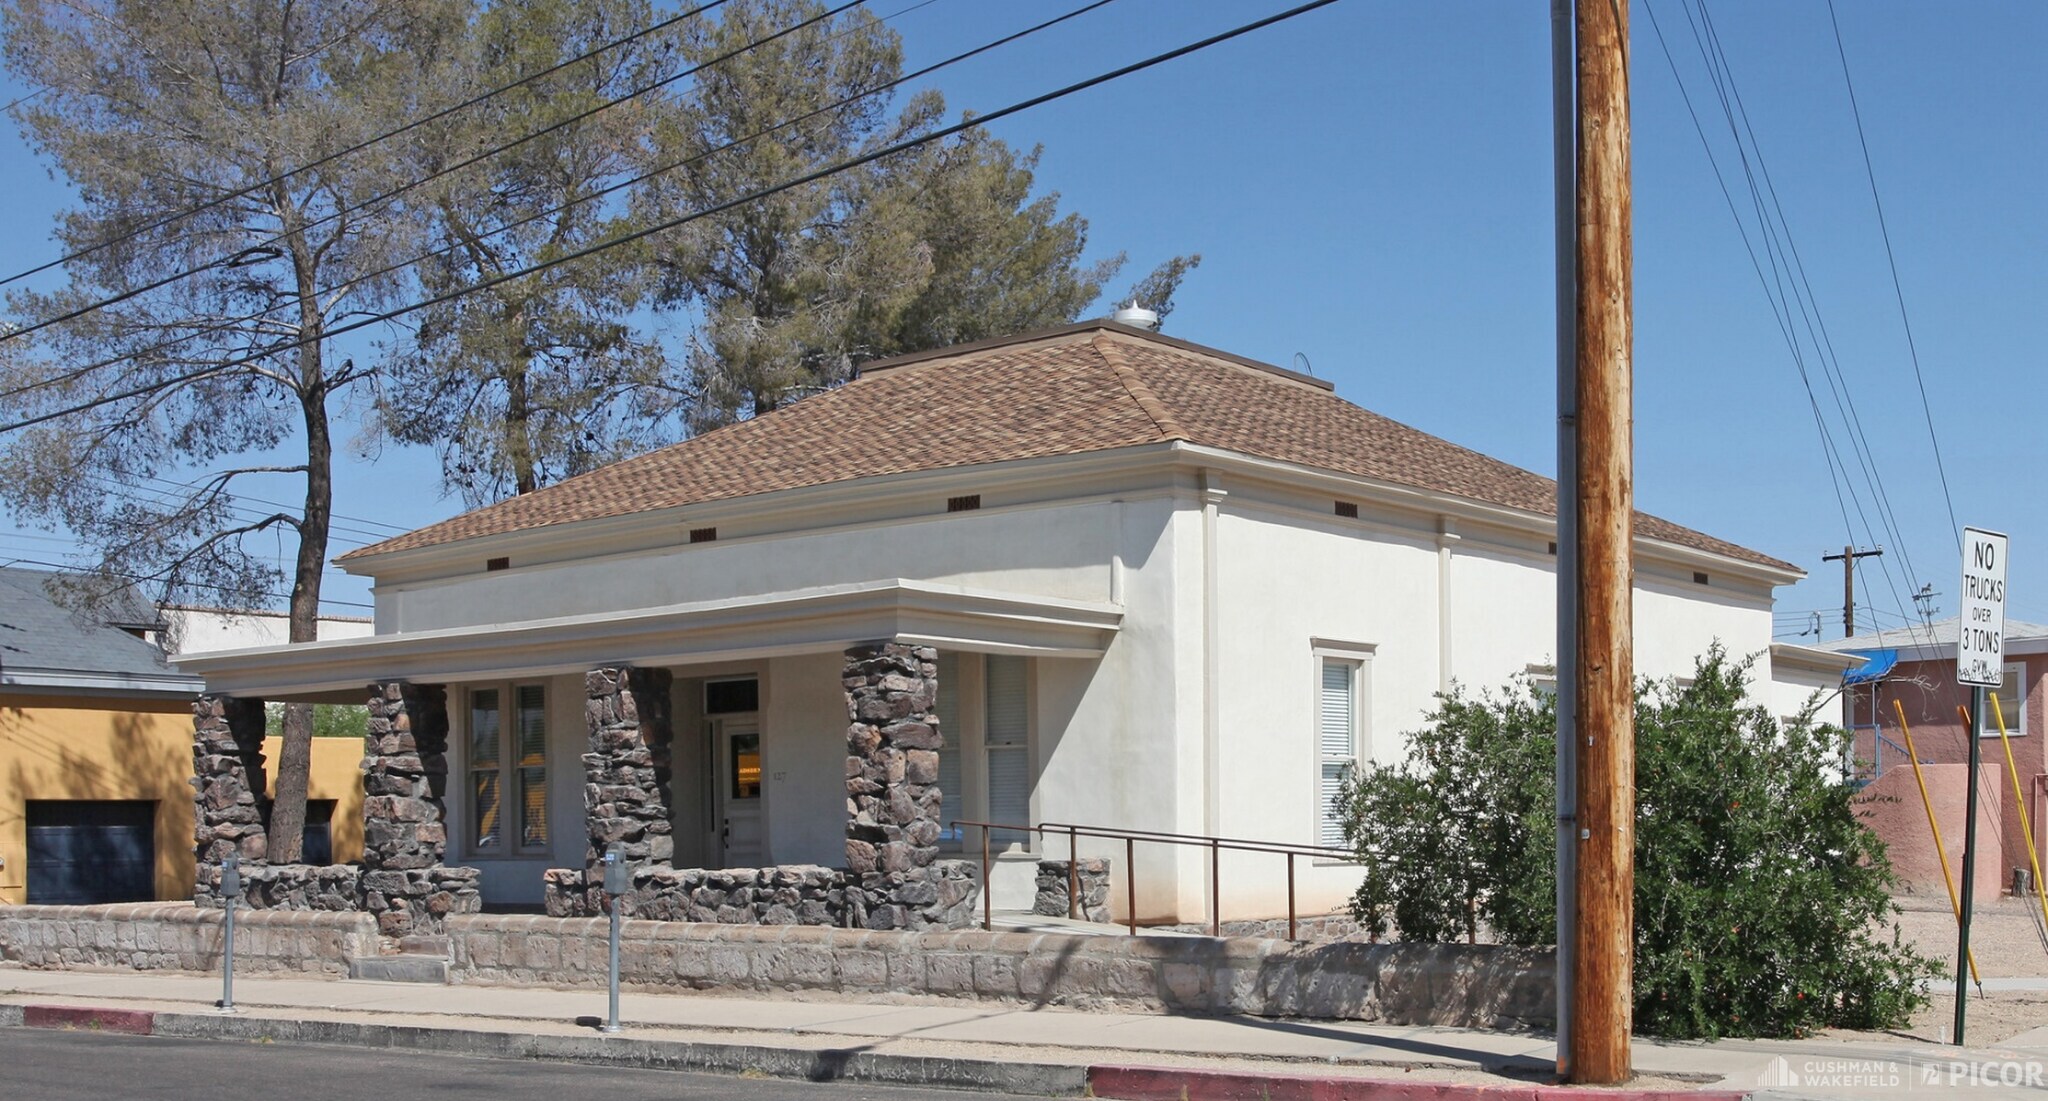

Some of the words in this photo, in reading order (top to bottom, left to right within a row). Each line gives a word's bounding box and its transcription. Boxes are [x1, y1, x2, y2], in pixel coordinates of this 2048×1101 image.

[1974, 541, 1995, 571] NO
[1964, 574, 2003, 603] TRUCKS
[1972, 607, 1992, 623] OVER
[1963, 627, 1969, 650] 3
[1973, 628, 2000, 654] TONS
